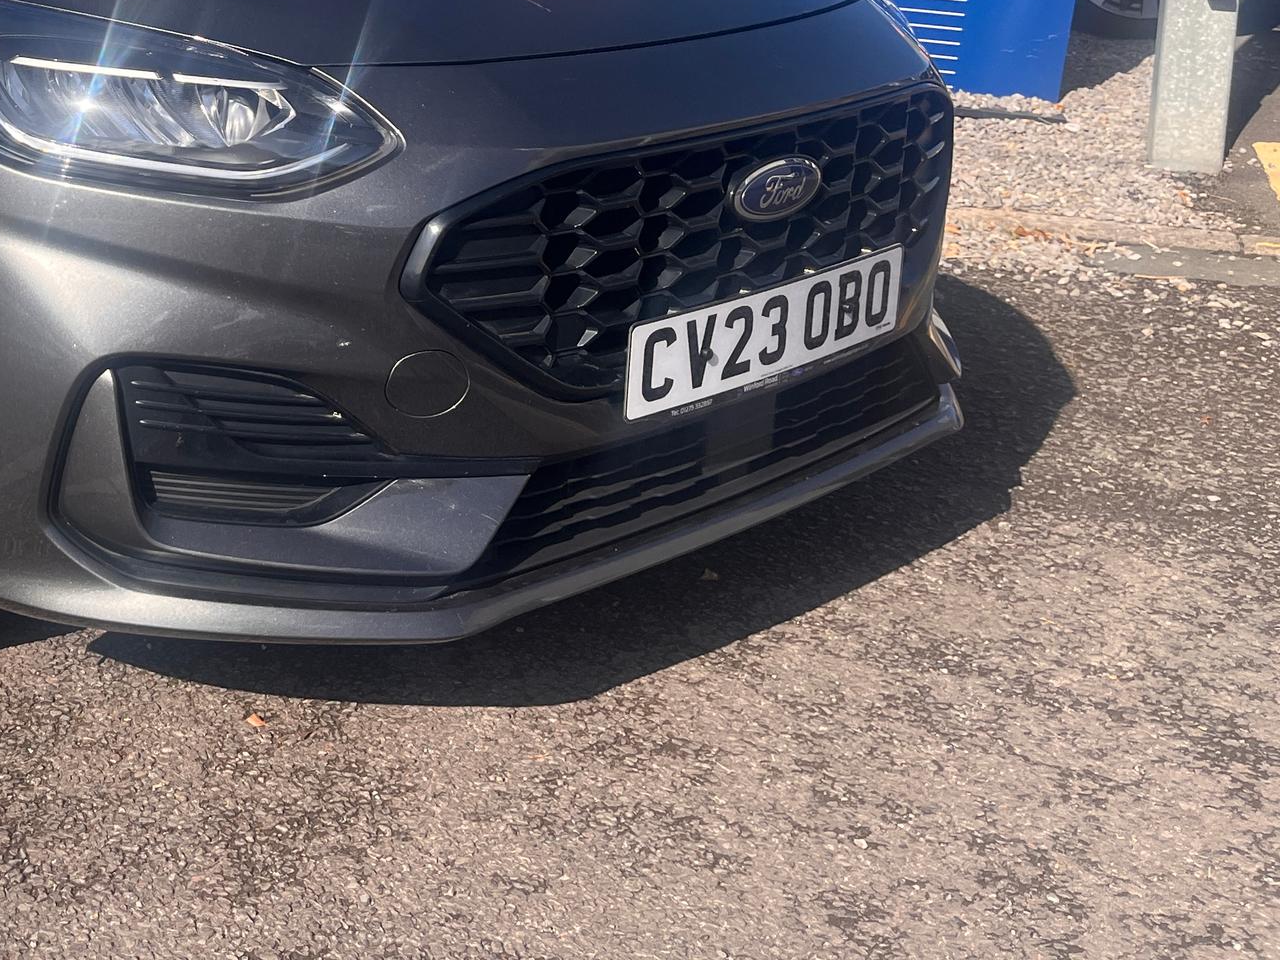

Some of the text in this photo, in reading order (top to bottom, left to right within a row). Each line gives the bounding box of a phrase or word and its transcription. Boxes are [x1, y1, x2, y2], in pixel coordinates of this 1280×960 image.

[759, 173, 806, 209] Ford
[641, 260, 891, 402] CV23 OBO
